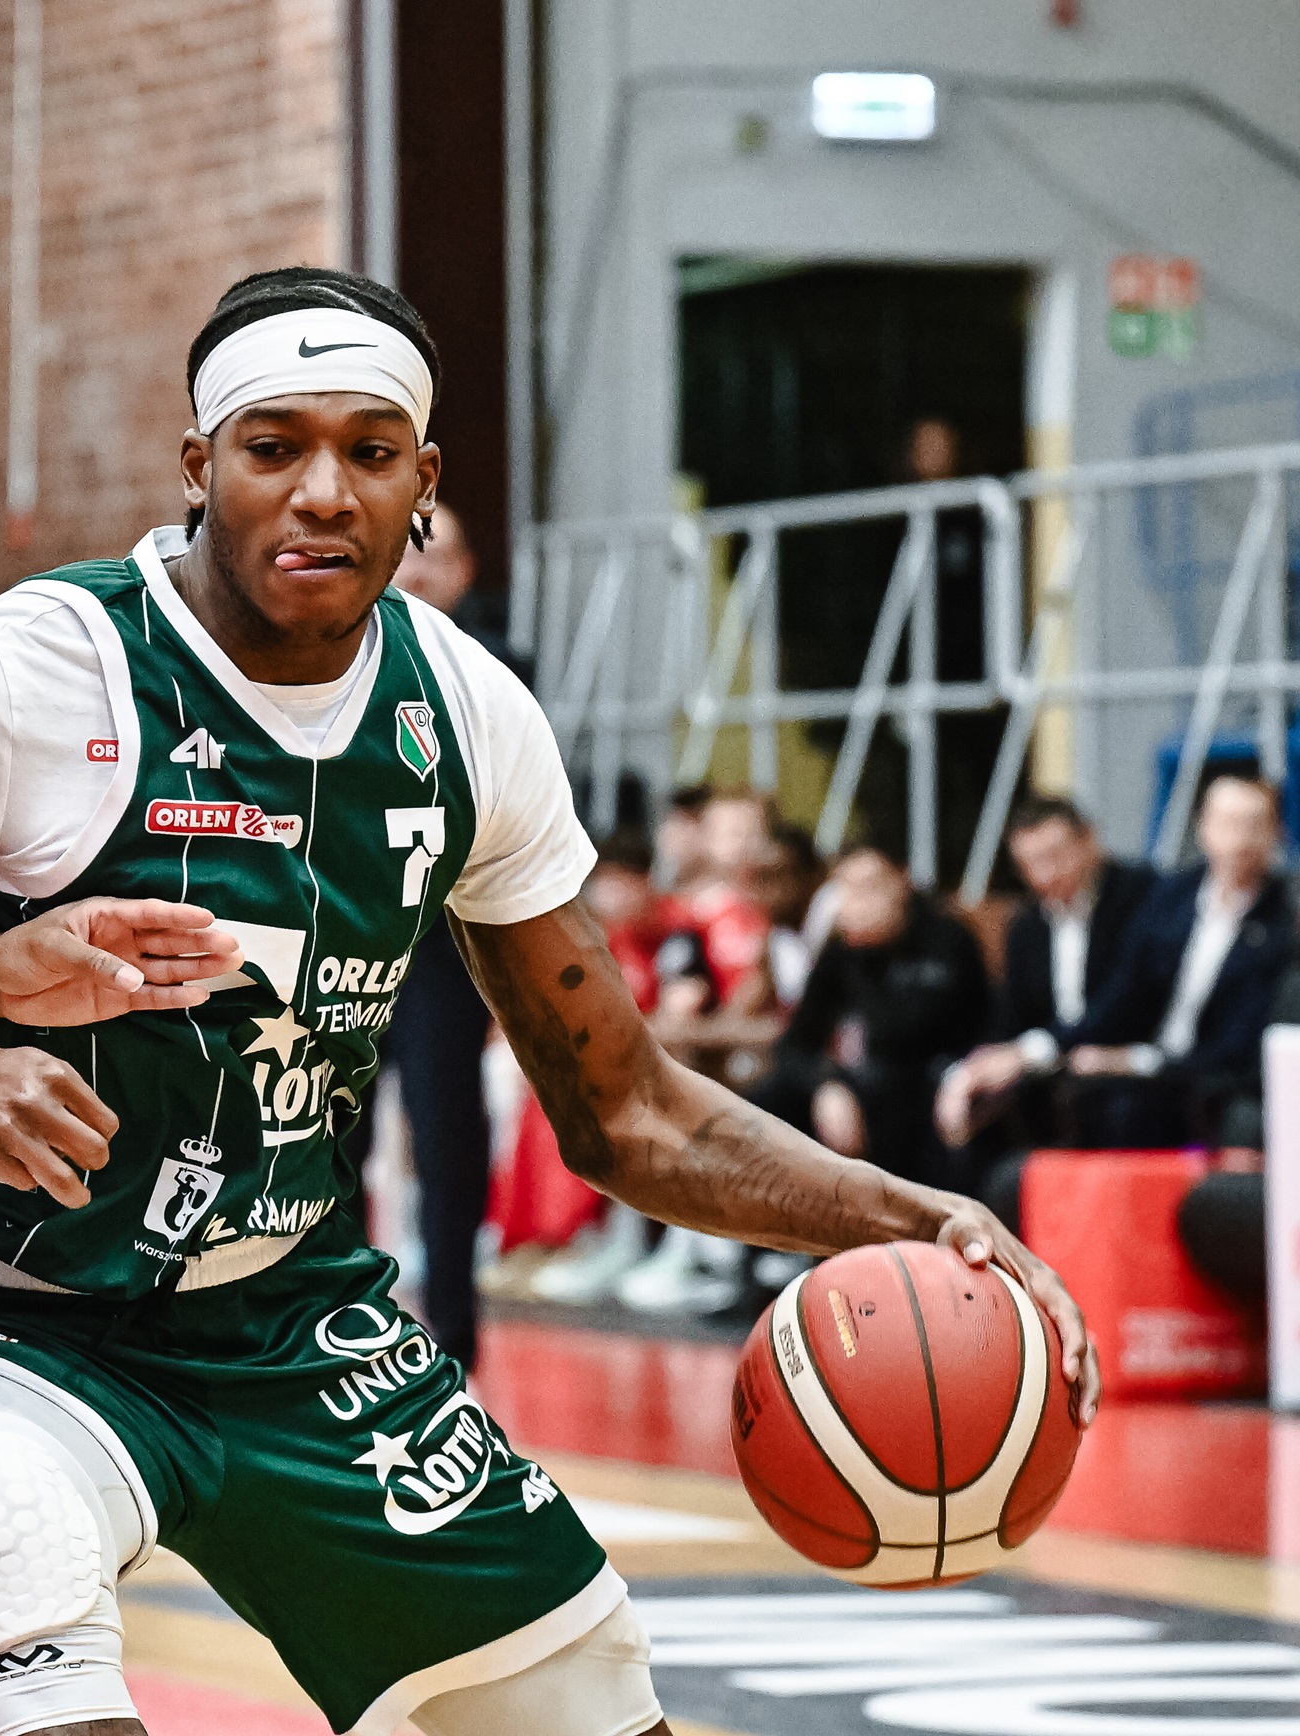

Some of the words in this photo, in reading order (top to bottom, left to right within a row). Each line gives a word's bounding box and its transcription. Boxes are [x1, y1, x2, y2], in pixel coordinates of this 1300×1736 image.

[155, 807, 231, 829] ORLEN
[385, 806, 445, 907] 7
[397, 1410, 483, 1509] LOTTO
[521, 1462, 559, 1514] 4F
